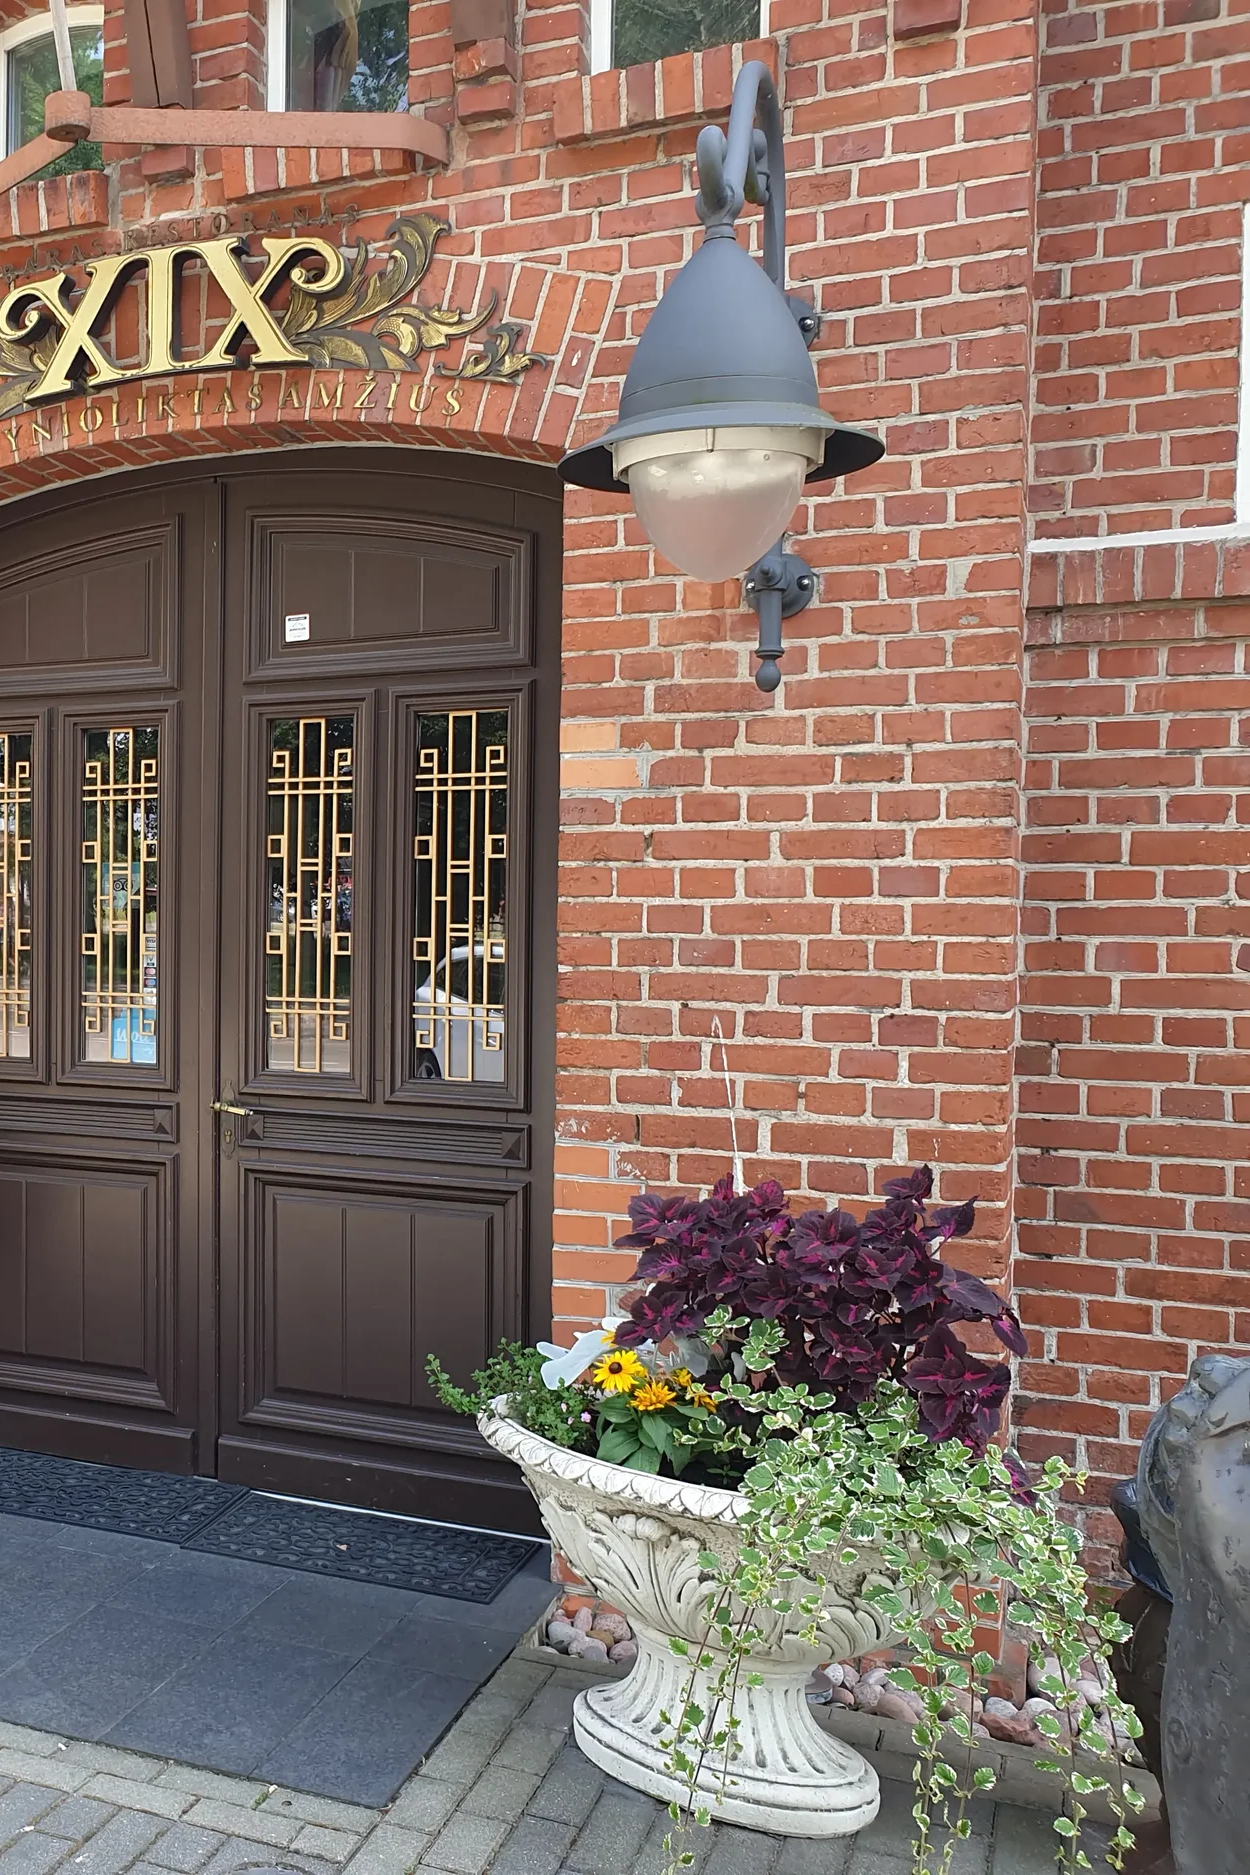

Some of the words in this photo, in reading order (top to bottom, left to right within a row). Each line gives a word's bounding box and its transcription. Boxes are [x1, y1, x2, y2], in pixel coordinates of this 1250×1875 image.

[0, 238, 108, 284] BARAS
[122, 203, 362, 252] RESTORANAS
[279, 373, 465, 417] AMŽIUS
